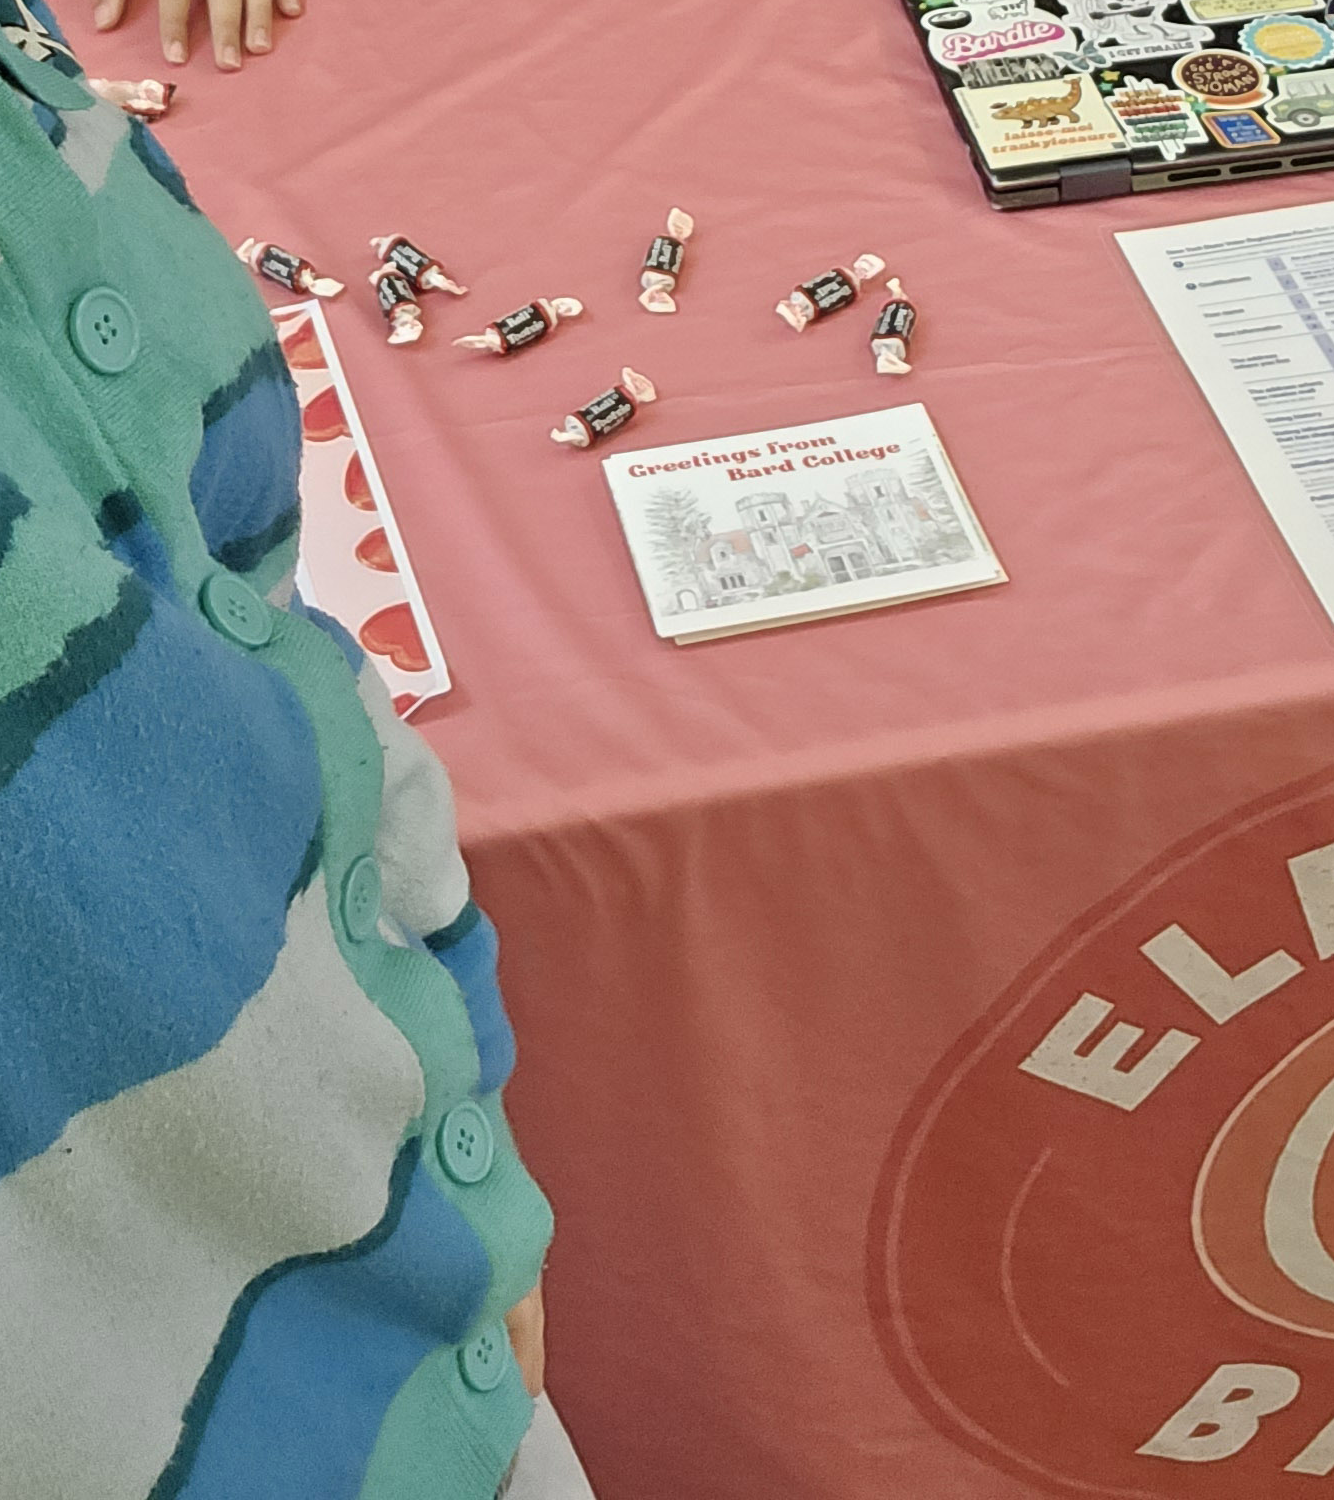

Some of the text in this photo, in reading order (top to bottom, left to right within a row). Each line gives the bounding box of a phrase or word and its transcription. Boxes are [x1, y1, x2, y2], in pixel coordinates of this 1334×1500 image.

[943, 21, 1064, 61] Bardie
[1192, 64, 1248, 85] STRONG
[1196, 74, 1256, 93] WOMAN
[992, 132, 1117, 154] trankylosaure
[1004, 122, 1094, 141] laisse-moi
[505, 318, 546, 345] Tootsie
[591, 399, 632, 432] Tootsie
[628, 434, 837, 478] Greetings from
[726, 442, 902, 482] Bard College
